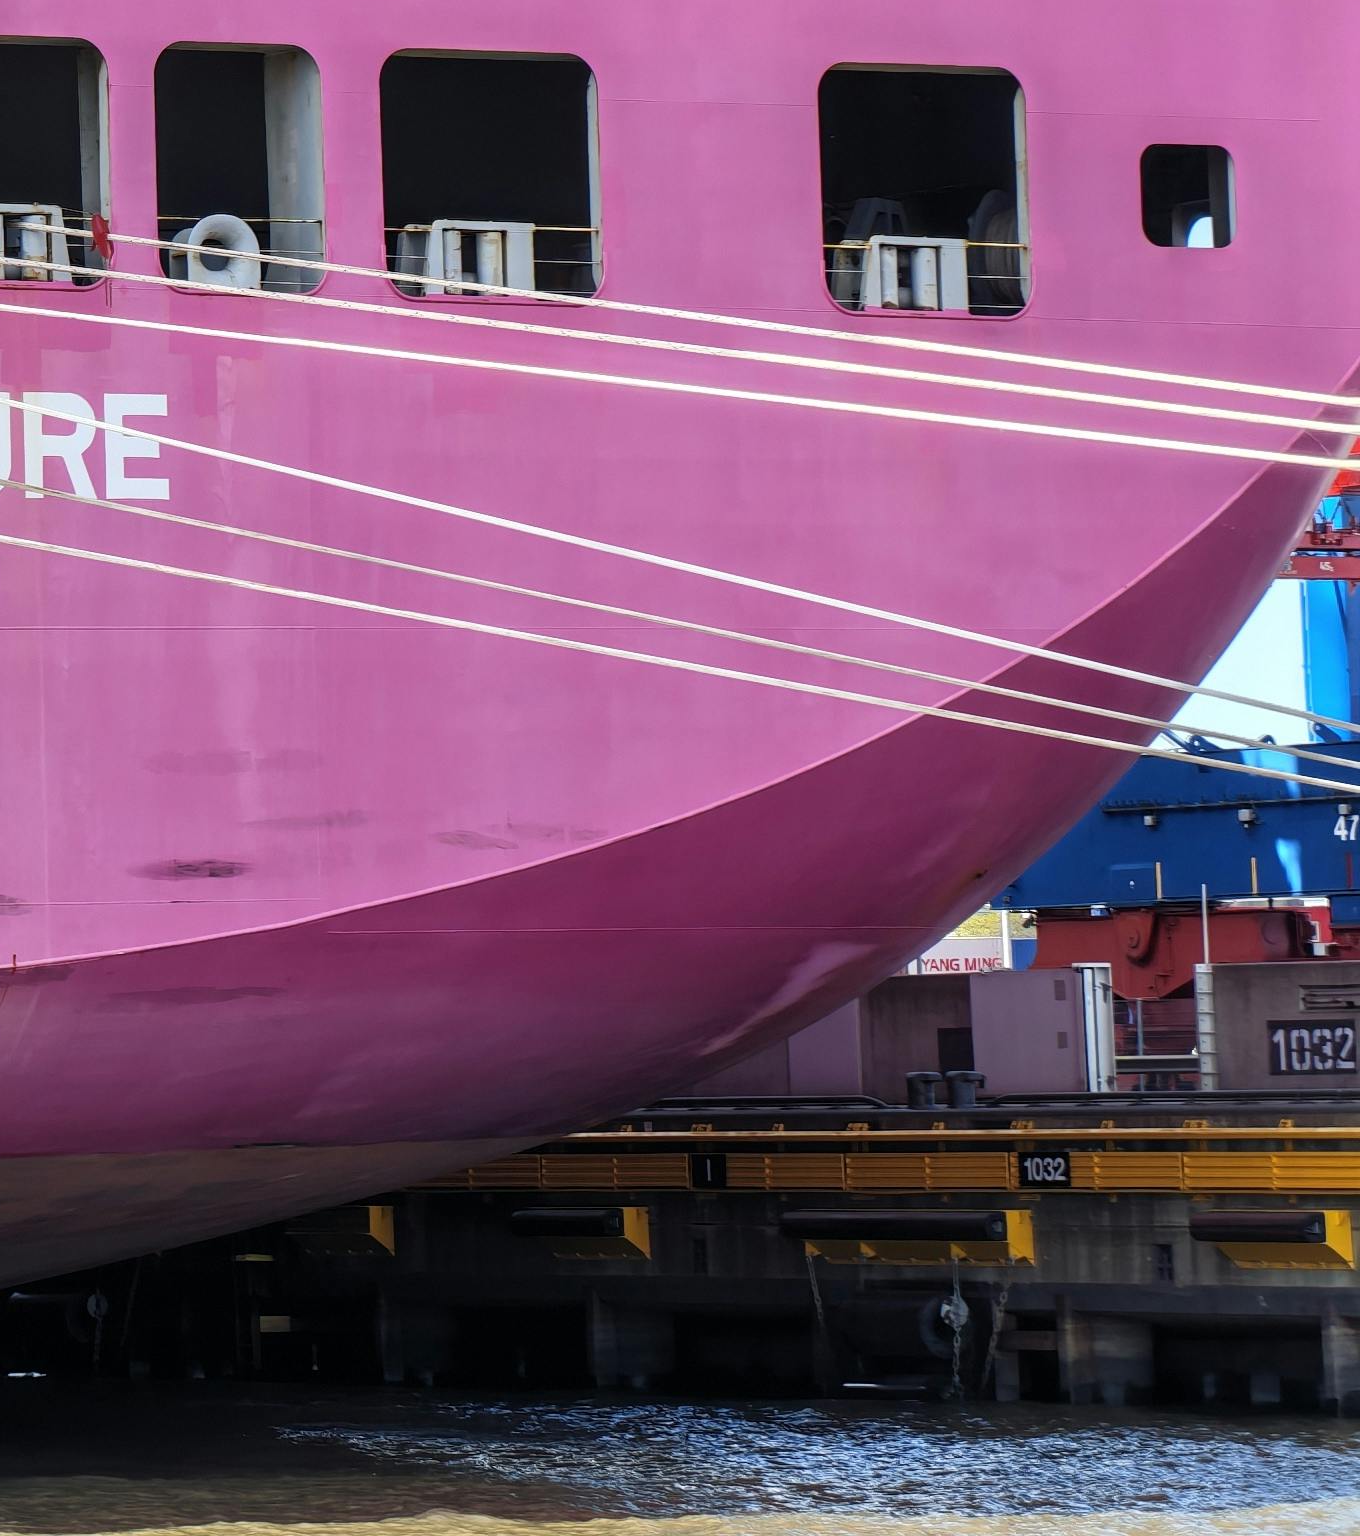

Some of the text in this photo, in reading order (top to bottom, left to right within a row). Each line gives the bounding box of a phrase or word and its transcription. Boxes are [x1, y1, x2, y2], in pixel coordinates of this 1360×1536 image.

[921, 957, 1003, 972] YANG MING
[1272, 1027, 1355, 1071] 1032
[1024, 1158, 1067, 1182] 1032
